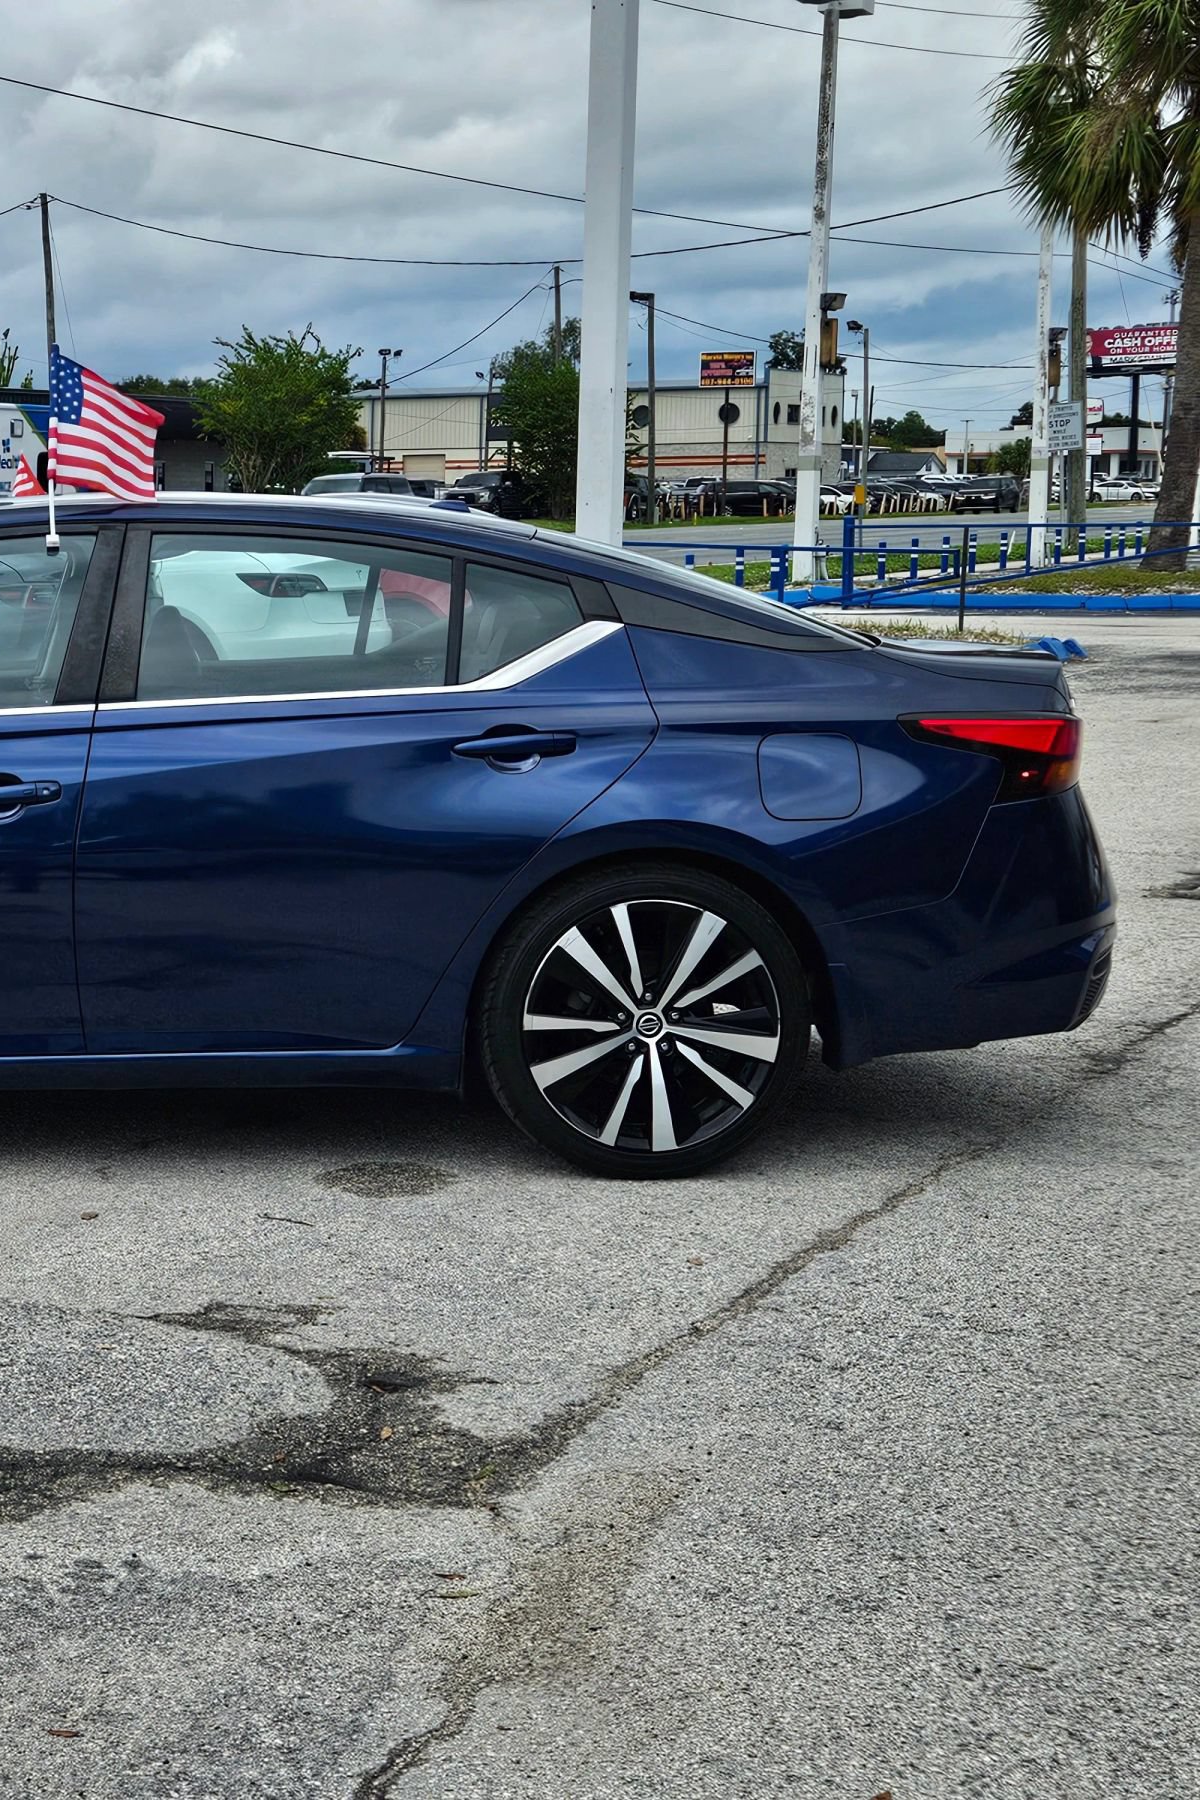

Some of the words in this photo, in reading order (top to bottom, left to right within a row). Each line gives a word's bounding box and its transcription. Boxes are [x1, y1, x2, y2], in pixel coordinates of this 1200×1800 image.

[1114, 329, 1179, 338] GUARANTEED
[1104, 337, 1140, 348] CASH
[1144, 336, 1178, 346] OFFE
[1048, 419, 1071, 428] STOP
